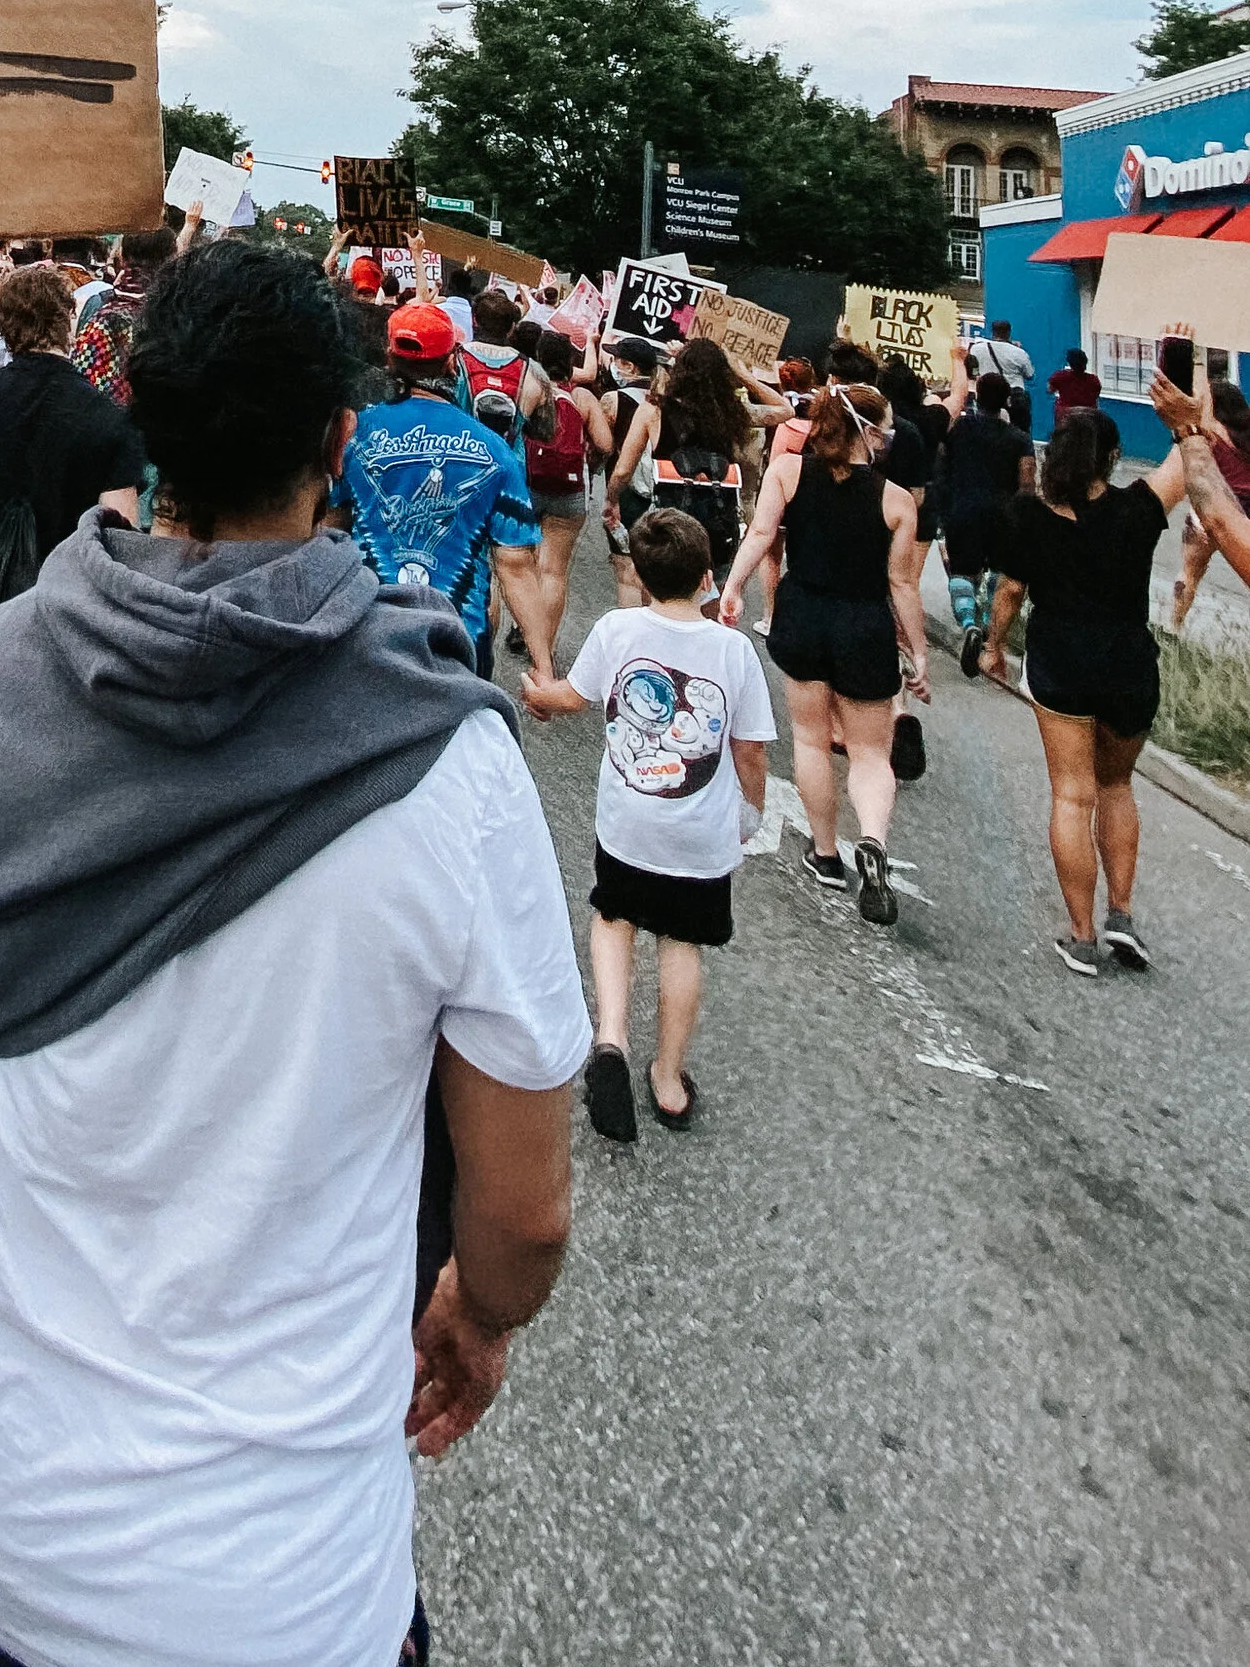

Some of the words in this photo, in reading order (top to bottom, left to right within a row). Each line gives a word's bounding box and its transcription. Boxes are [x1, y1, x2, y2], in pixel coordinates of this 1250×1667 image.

[1144, 132, 1250, 198] Domino
[666, 176, 685, 186] VCU
[339, 185, 416, 219] LIVES
[666, 197, 684, 207] VCU
[665, 211, 696, 223] Science
[698, 215, 732, 226] Museum
[705, 229, 740, 241] Museum
[383, 249, 404, 263] NO
[403, 265, 440, 281] PECE
[629, 269, 704, 305] FIRST
[631, 292, 672, 319] AID
[701, 291, 726, 316] NO
[726, 299, 787, 336] JUSTICE
[870, 295, 934, 328] BLACK
[723, 329, 779, 368] PEACE
[403, 424, 488, 455] Angeles
[636, 765, 669, 776] NASA
